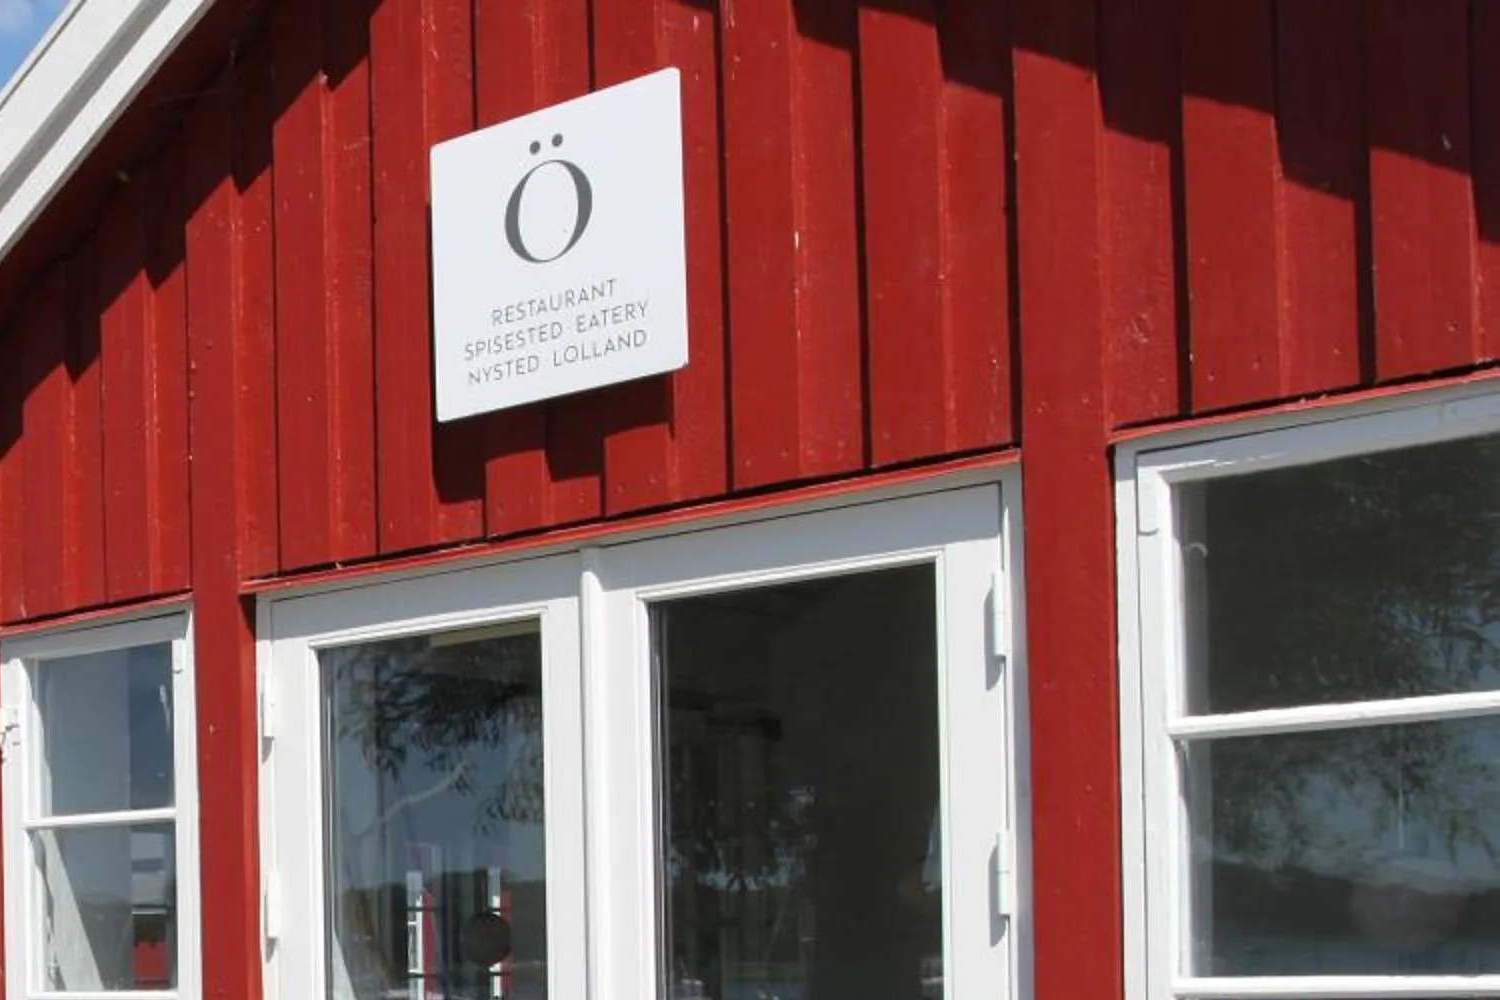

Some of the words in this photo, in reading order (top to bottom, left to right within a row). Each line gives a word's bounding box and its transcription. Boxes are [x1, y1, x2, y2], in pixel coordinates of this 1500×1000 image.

[504, 133, 593, 264] Ö
[464, 321, 563, 361] SPISESTED
[576, 300, 649, 334] EATERY
[491, 278, 617, 327] RESTAURANT
[468, 355, 540, 385] NYSTED
[553, 329, 647, 367] LOLLAND
